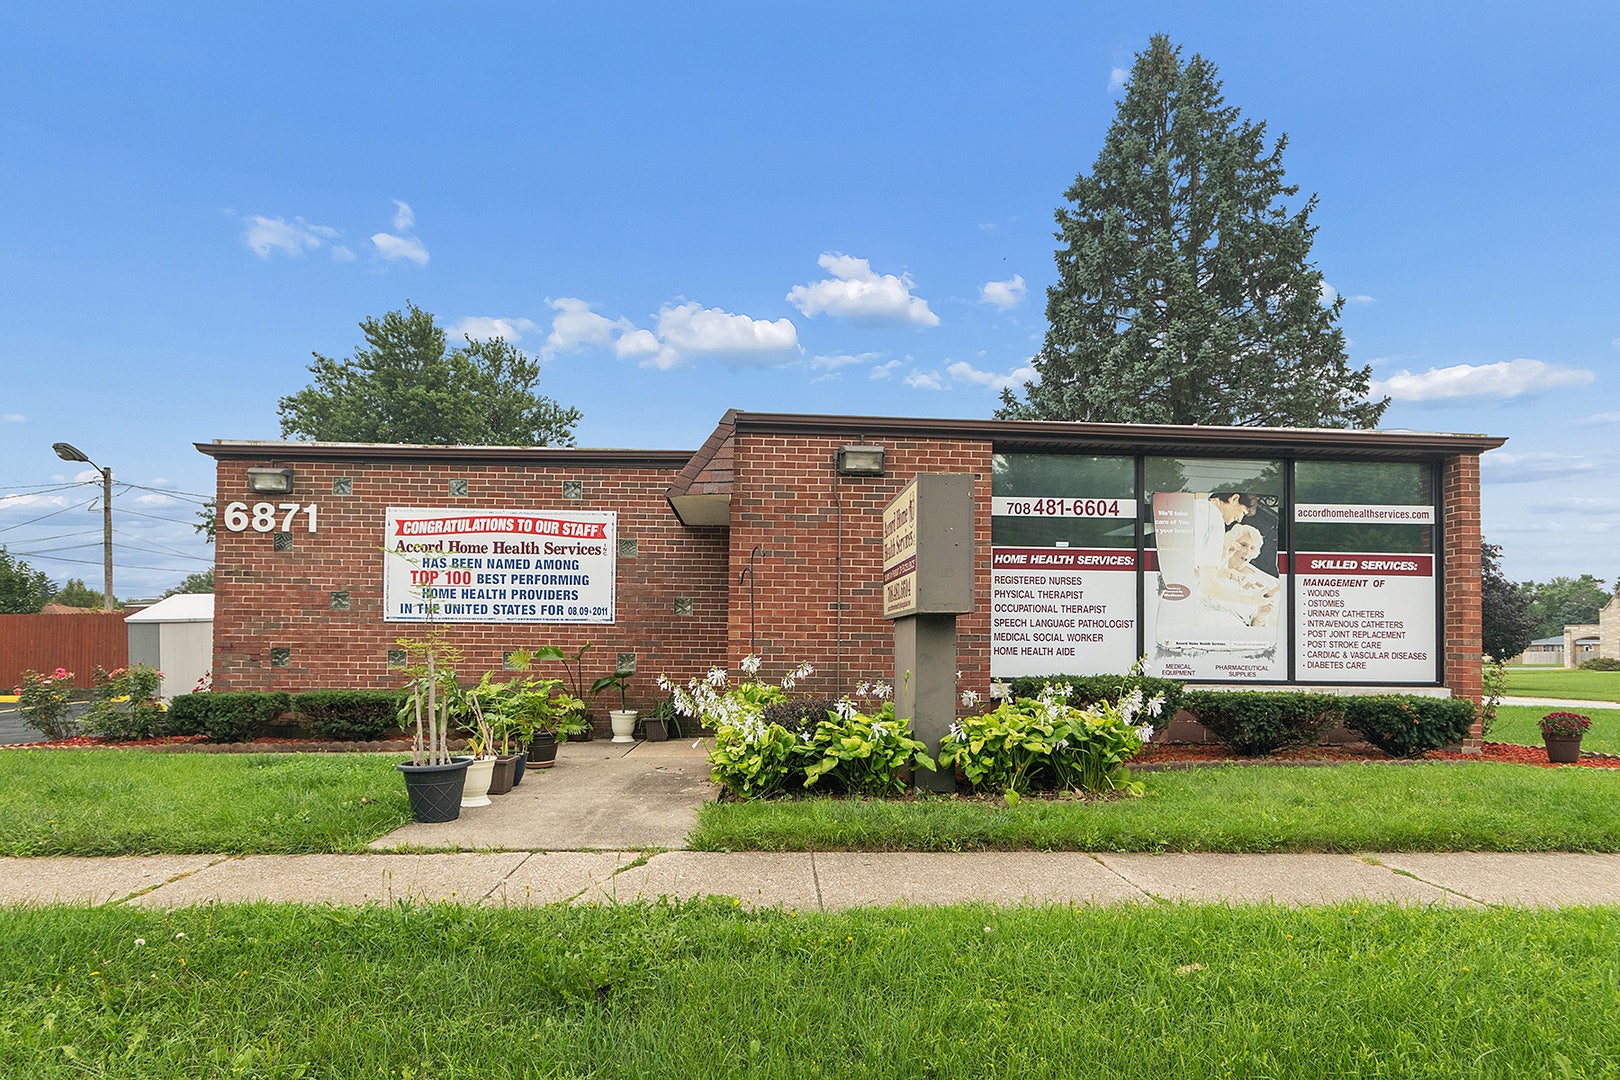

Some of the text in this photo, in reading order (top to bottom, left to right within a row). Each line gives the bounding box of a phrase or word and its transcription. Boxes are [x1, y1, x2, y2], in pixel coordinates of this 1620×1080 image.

[1006, 499, 1119, 516] 708 481-6604
[224, 502, 317, 532] 6871
[1298, 508, 1430, 520] accordhomehealthservices.com
[403, 518, 598, 537] CONGRATULATIONS TO OUR STAFF
[395, 540, 443, 553] Accord
[448, 541, 488, 554] Home
[493, 541, 540, 554] Health
[544, 542, 601, 555] Services
[422, 558, 579, 570] HAS BEEN NAMED AMONG
[994, 554, 1135, 565] HOME HEALTH SERVICES:
[1310, 560, 1418, 571] SKILLED SERVICES:
[410, 570, 589, 586] TOP 100 BEST PERFORMING
[994, 576, 1082, 585] REGISTERED NURSES
[1303, 579, 1385, 588] MANAGEMENT OF
[422, 588, 578, 600] HOME HEALTH PROVIDERS
[994, 590, 1084, 599] PHYSICAL THERAPIST
[400, 603, 412, 614] IN
[418, 604, 440, 614] THE
[444, 604, 488, 615] UNITED
[493, 604, 536, 615] STATES
[541, 605, 564, 615] FOR
[994, 604, 1106, 614] OCCUPATIONAL THERAPIST
[1307, 610, 1384, 618] URINARY CATHETERS
[994, 619, 1134, 628] SPEECH LANGUAGE PATHOLOGIST
[1361, 621, 1403, 629] CATHETERS
[994, 633, 1104, 642] MEDICAL SOCIAL WORKER
[1307, 630, 1326, 638] POST
[1352, 631, 1406, 639] REPLACEMENT
[1329, 641, 1359, 649] STROKE
[994, 647, 1075, 656] HOME HEALTH AIDE
[1307, 651, 1340, 659] CARDIAC
[1392, 652, 1427, 660] DISEASES
